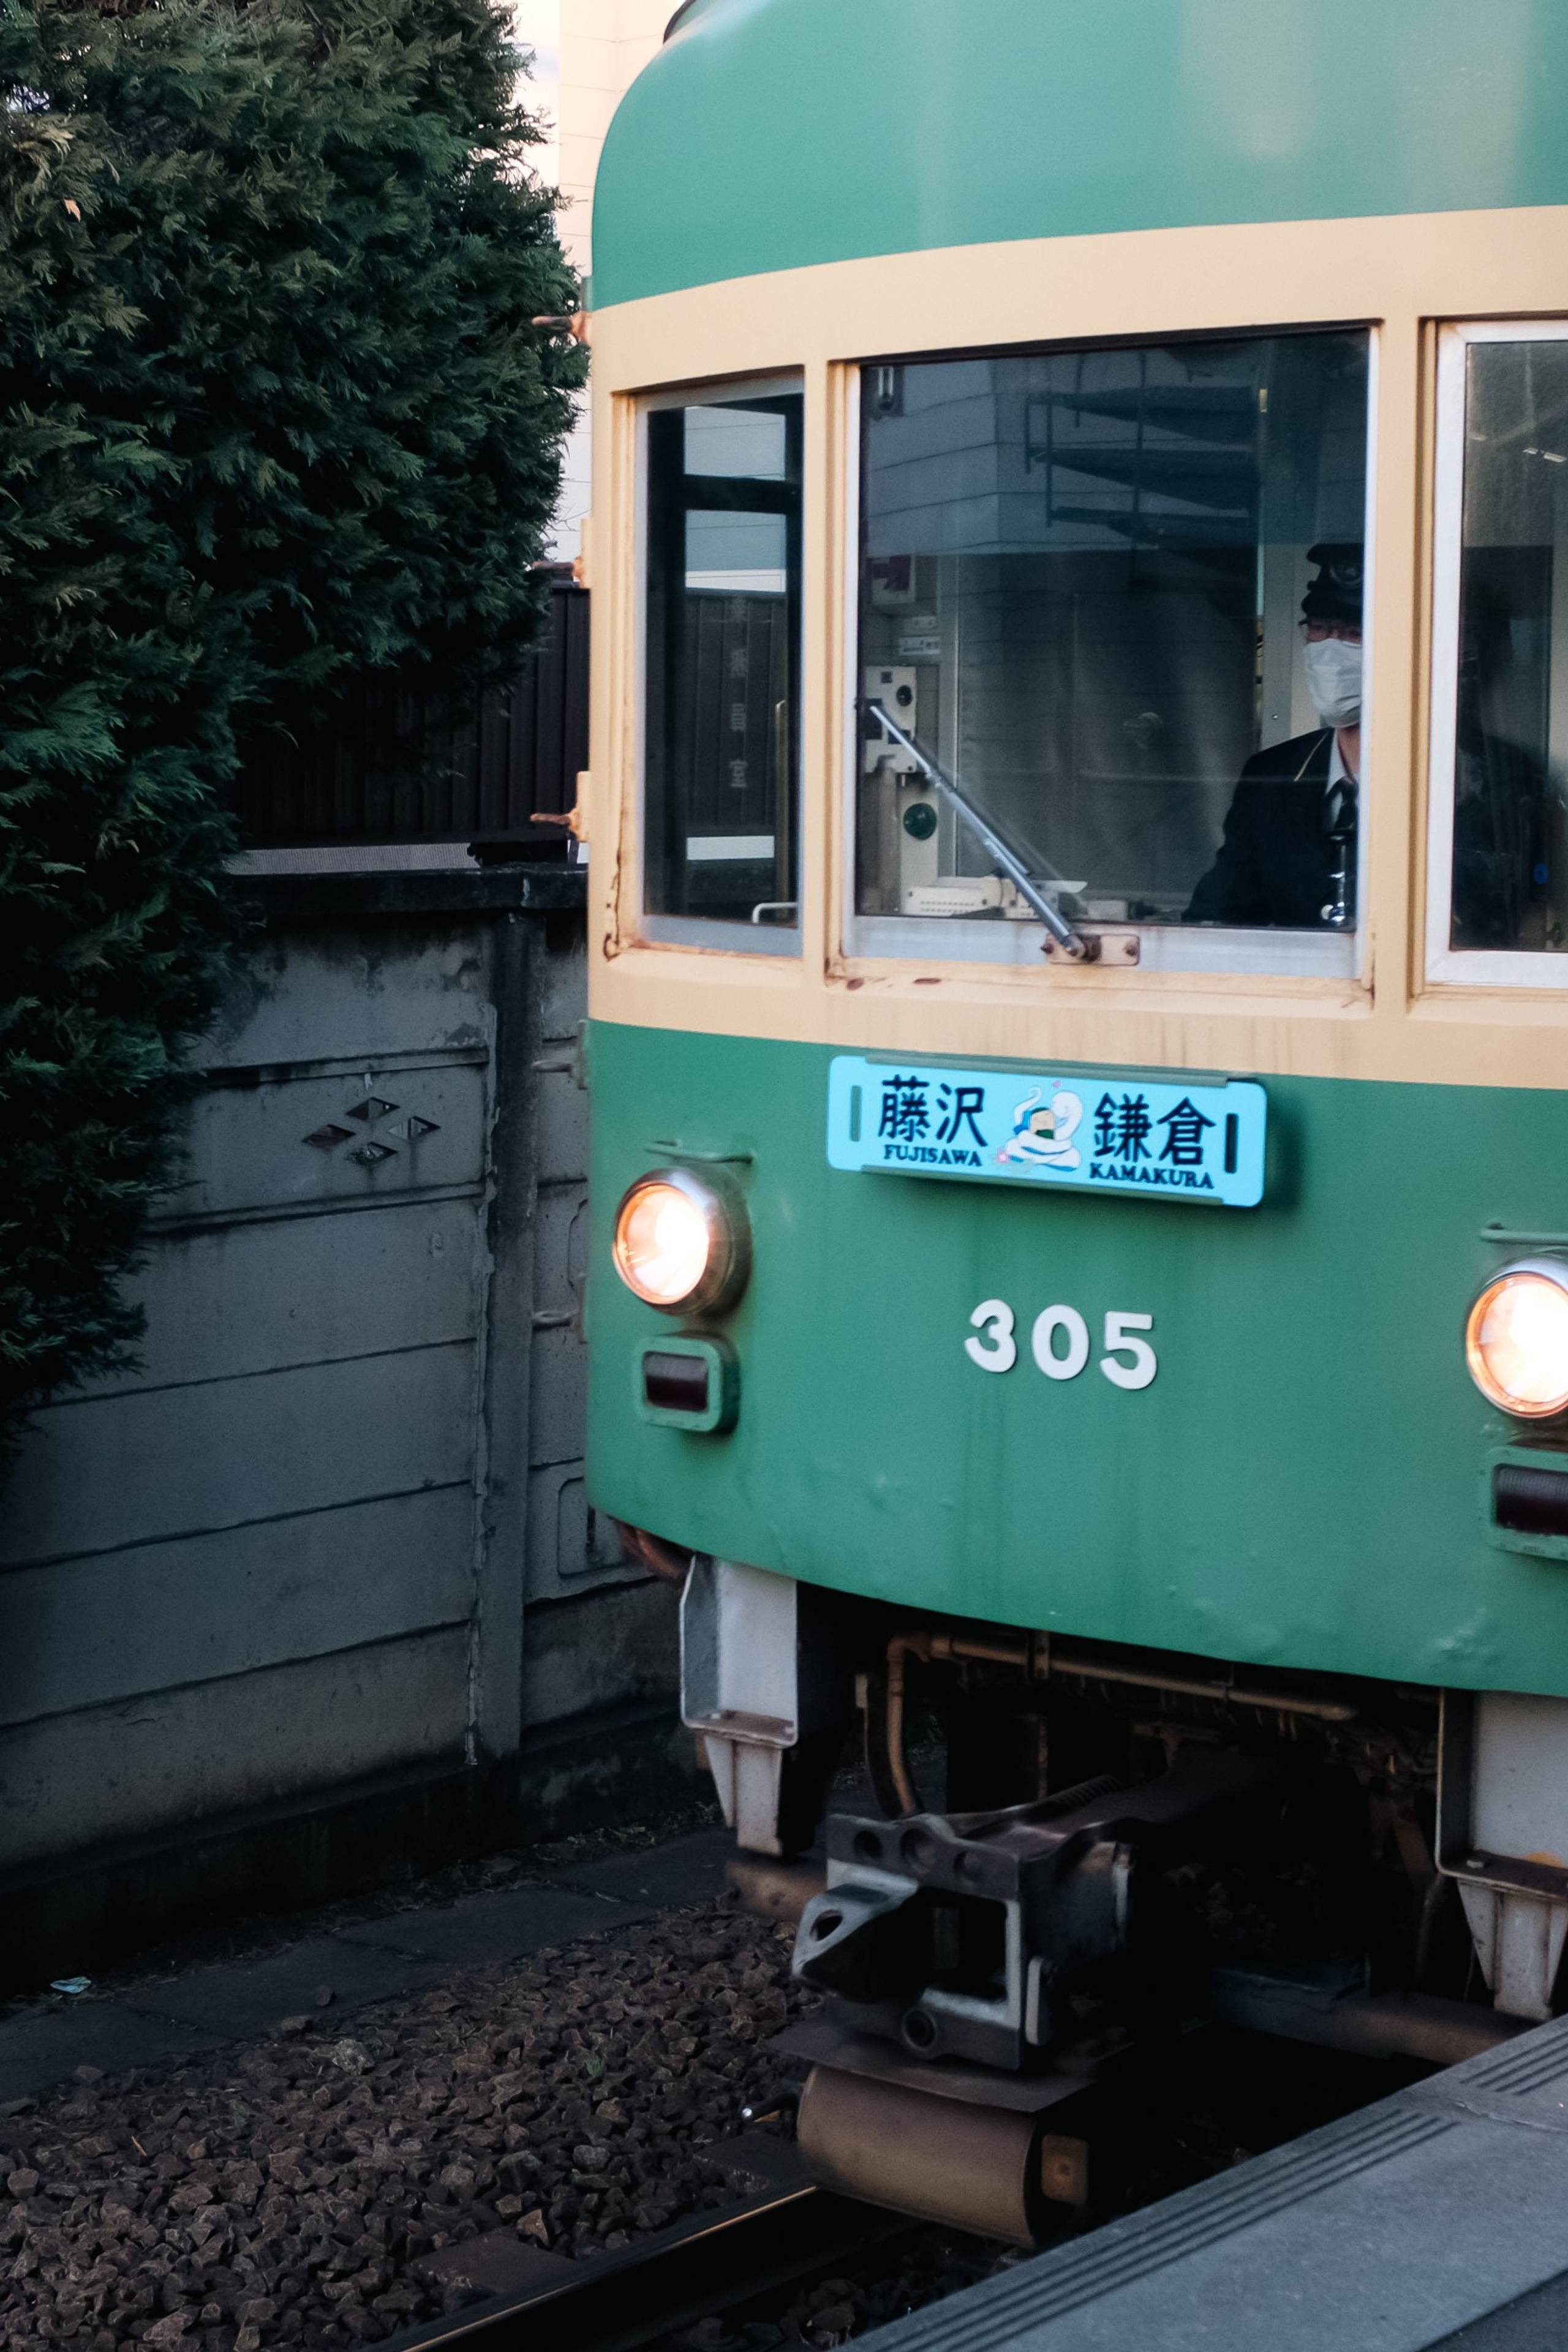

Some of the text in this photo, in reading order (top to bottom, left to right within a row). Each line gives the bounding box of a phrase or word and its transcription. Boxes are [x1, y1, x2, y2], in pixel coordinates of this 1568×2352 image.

[878, 1074, 988, 1147] 藤沢
[1093, 1092, 1216, 1166] 鎌倉
[883, 1144, 983, 1166] FUJISAWA
[1089, 1162, 1215, 1189] KAMAKURA
[964, 1298, 1158, 1390] 305
